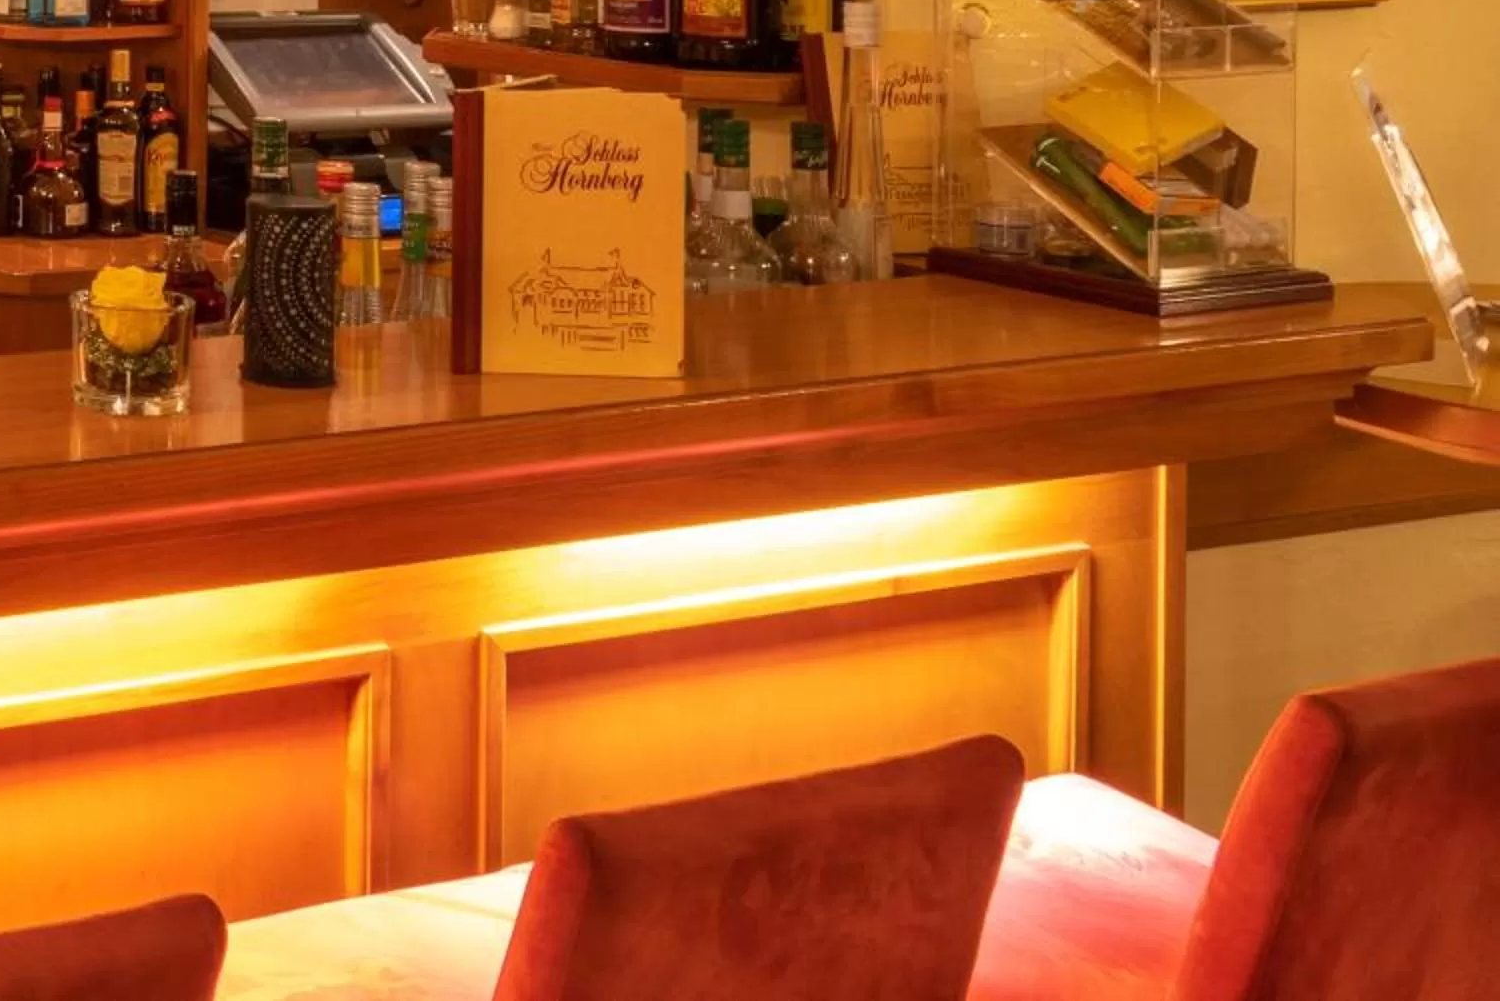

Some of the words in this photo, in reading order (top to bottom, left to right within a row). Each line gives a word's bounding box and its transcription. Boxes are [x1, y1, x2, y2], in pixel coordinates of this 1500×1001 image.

[886, 61, 946, 89] Schlos
[562, 129, 642, 167] Schloss
[519, 153, 645, 205] Hornberg
